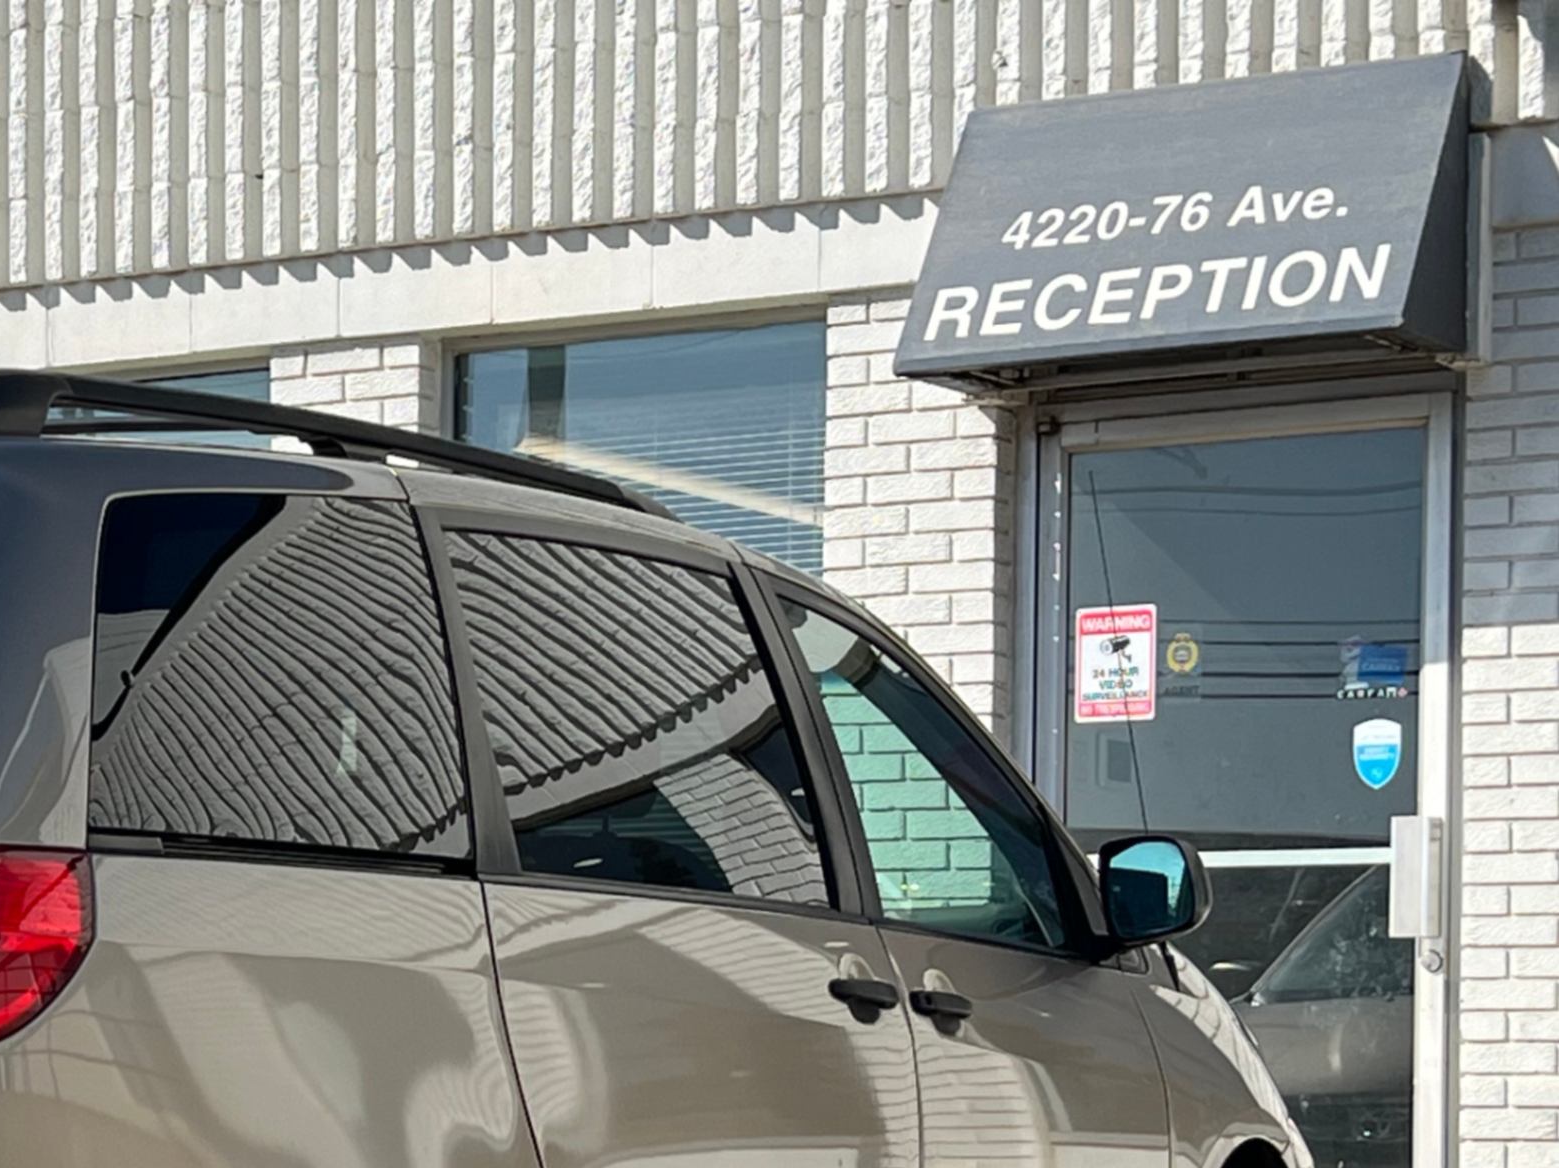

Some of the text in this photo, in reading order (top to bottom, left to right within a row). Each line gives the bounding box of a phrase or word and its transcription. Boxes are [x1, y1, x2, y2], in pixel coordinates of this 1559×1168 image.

[1002, 185, 1349, 250] 4220-76 Ave.
[923, 244, 1391, 341] RECEPTION
[1081, 613, 1151, 632] WARNING
[1092, 665, 1139, 678] 24 HOUR
[1099, 679, 1133, 689] VIDEO
